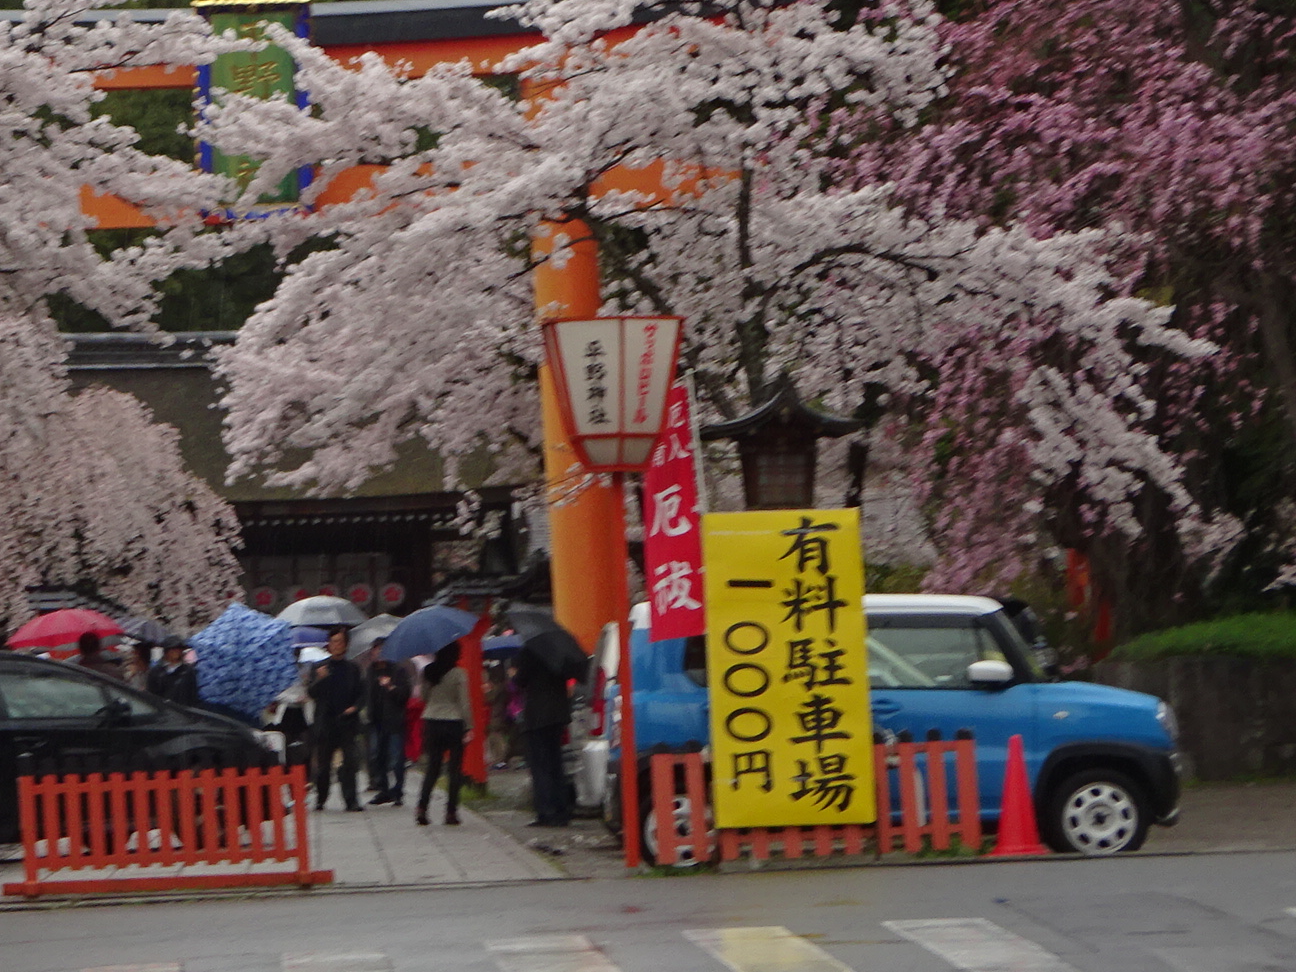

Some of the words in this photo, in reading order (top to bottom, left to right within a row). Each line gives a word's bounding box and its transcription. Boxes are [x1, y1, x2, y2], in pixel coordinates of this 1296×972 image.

[777, 516, 858, 814] 有料駐車場
